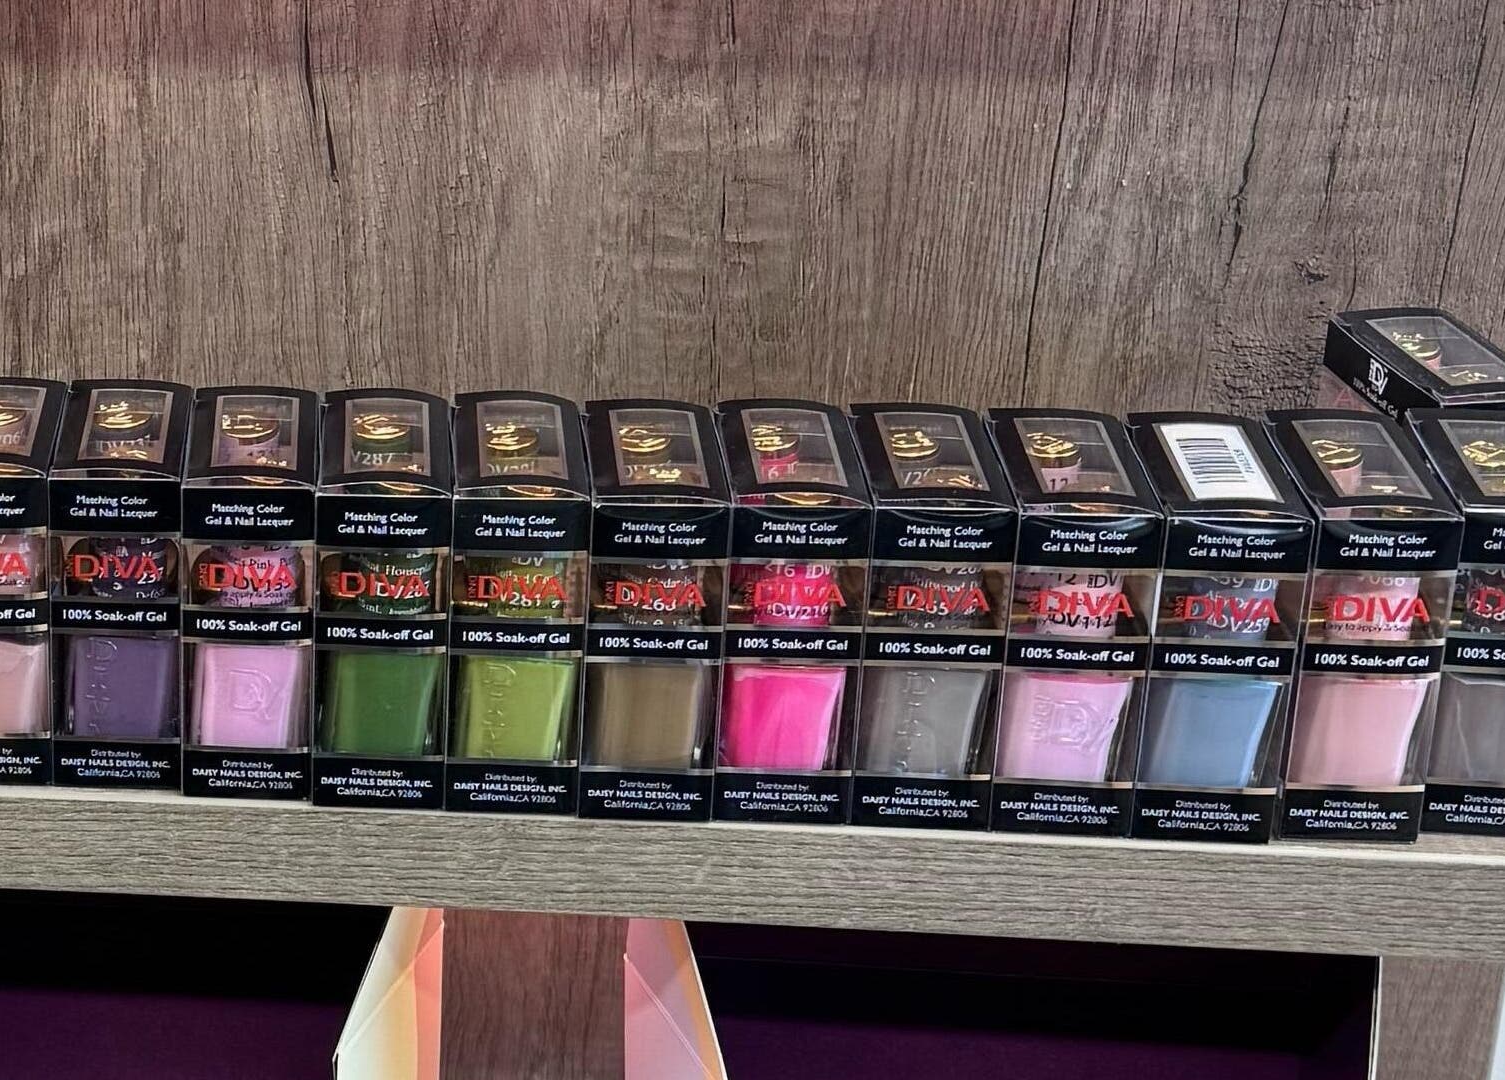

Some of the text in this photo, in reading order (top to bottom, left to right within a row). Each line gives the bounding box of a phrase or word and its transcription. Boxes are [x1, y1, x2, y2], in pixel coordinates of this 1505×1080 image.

[1348, 534, 1428, 547] Matching Color
[1339, 547, 1437, 560] Gel & Nail Lacquer
[73, 555, 161, 579] DIVA
[207, 564, 296, 588] DIVA
[339, 572, 429, 597] DIVA
[477, 576, 569, 600] DIVA
[615, 582, 706, 607] DIVA
[755, 581, 846, 607] DIVA
[896, 586, 990, 612] DIVA
[1038, 590, 1134, 618] DIVA
[1183, 596, 1279, 624] DIVA
[1334, 595, 1431, 623] DIVA
[14, 607, 36, 620] Gel
[62, 608, 167, 622] 100% Soak-off Gel
[196, 618, 302, 632] 100% Soak-off Gel
[327, 626, 434, 641] 100% Soak-off Gel
[462, 630, 571, 644] 100% Soak-off Gel
[599, 636, 709, 651] 100% Soak-off Gel
[737, 637, 849, 651] 100% Soak-off Gel
[879, 641, 992, 656] 100% Soak-off Gel
[1020, 647, 1135, 663] 100% Soak-off Gel
[1164, 652, 1280, 668] 100% Soak-off Gel
[1314, 652, 1430, 668] 100% Soak-off Gel
[1456, 647, 1489, 661] 100%
[894, 786, 937, 798] Distributed
[862, 795, 890, 804] DAISY
[891, 796, 919, 805] NAILS
[959, 799, 981, 808] INC.
